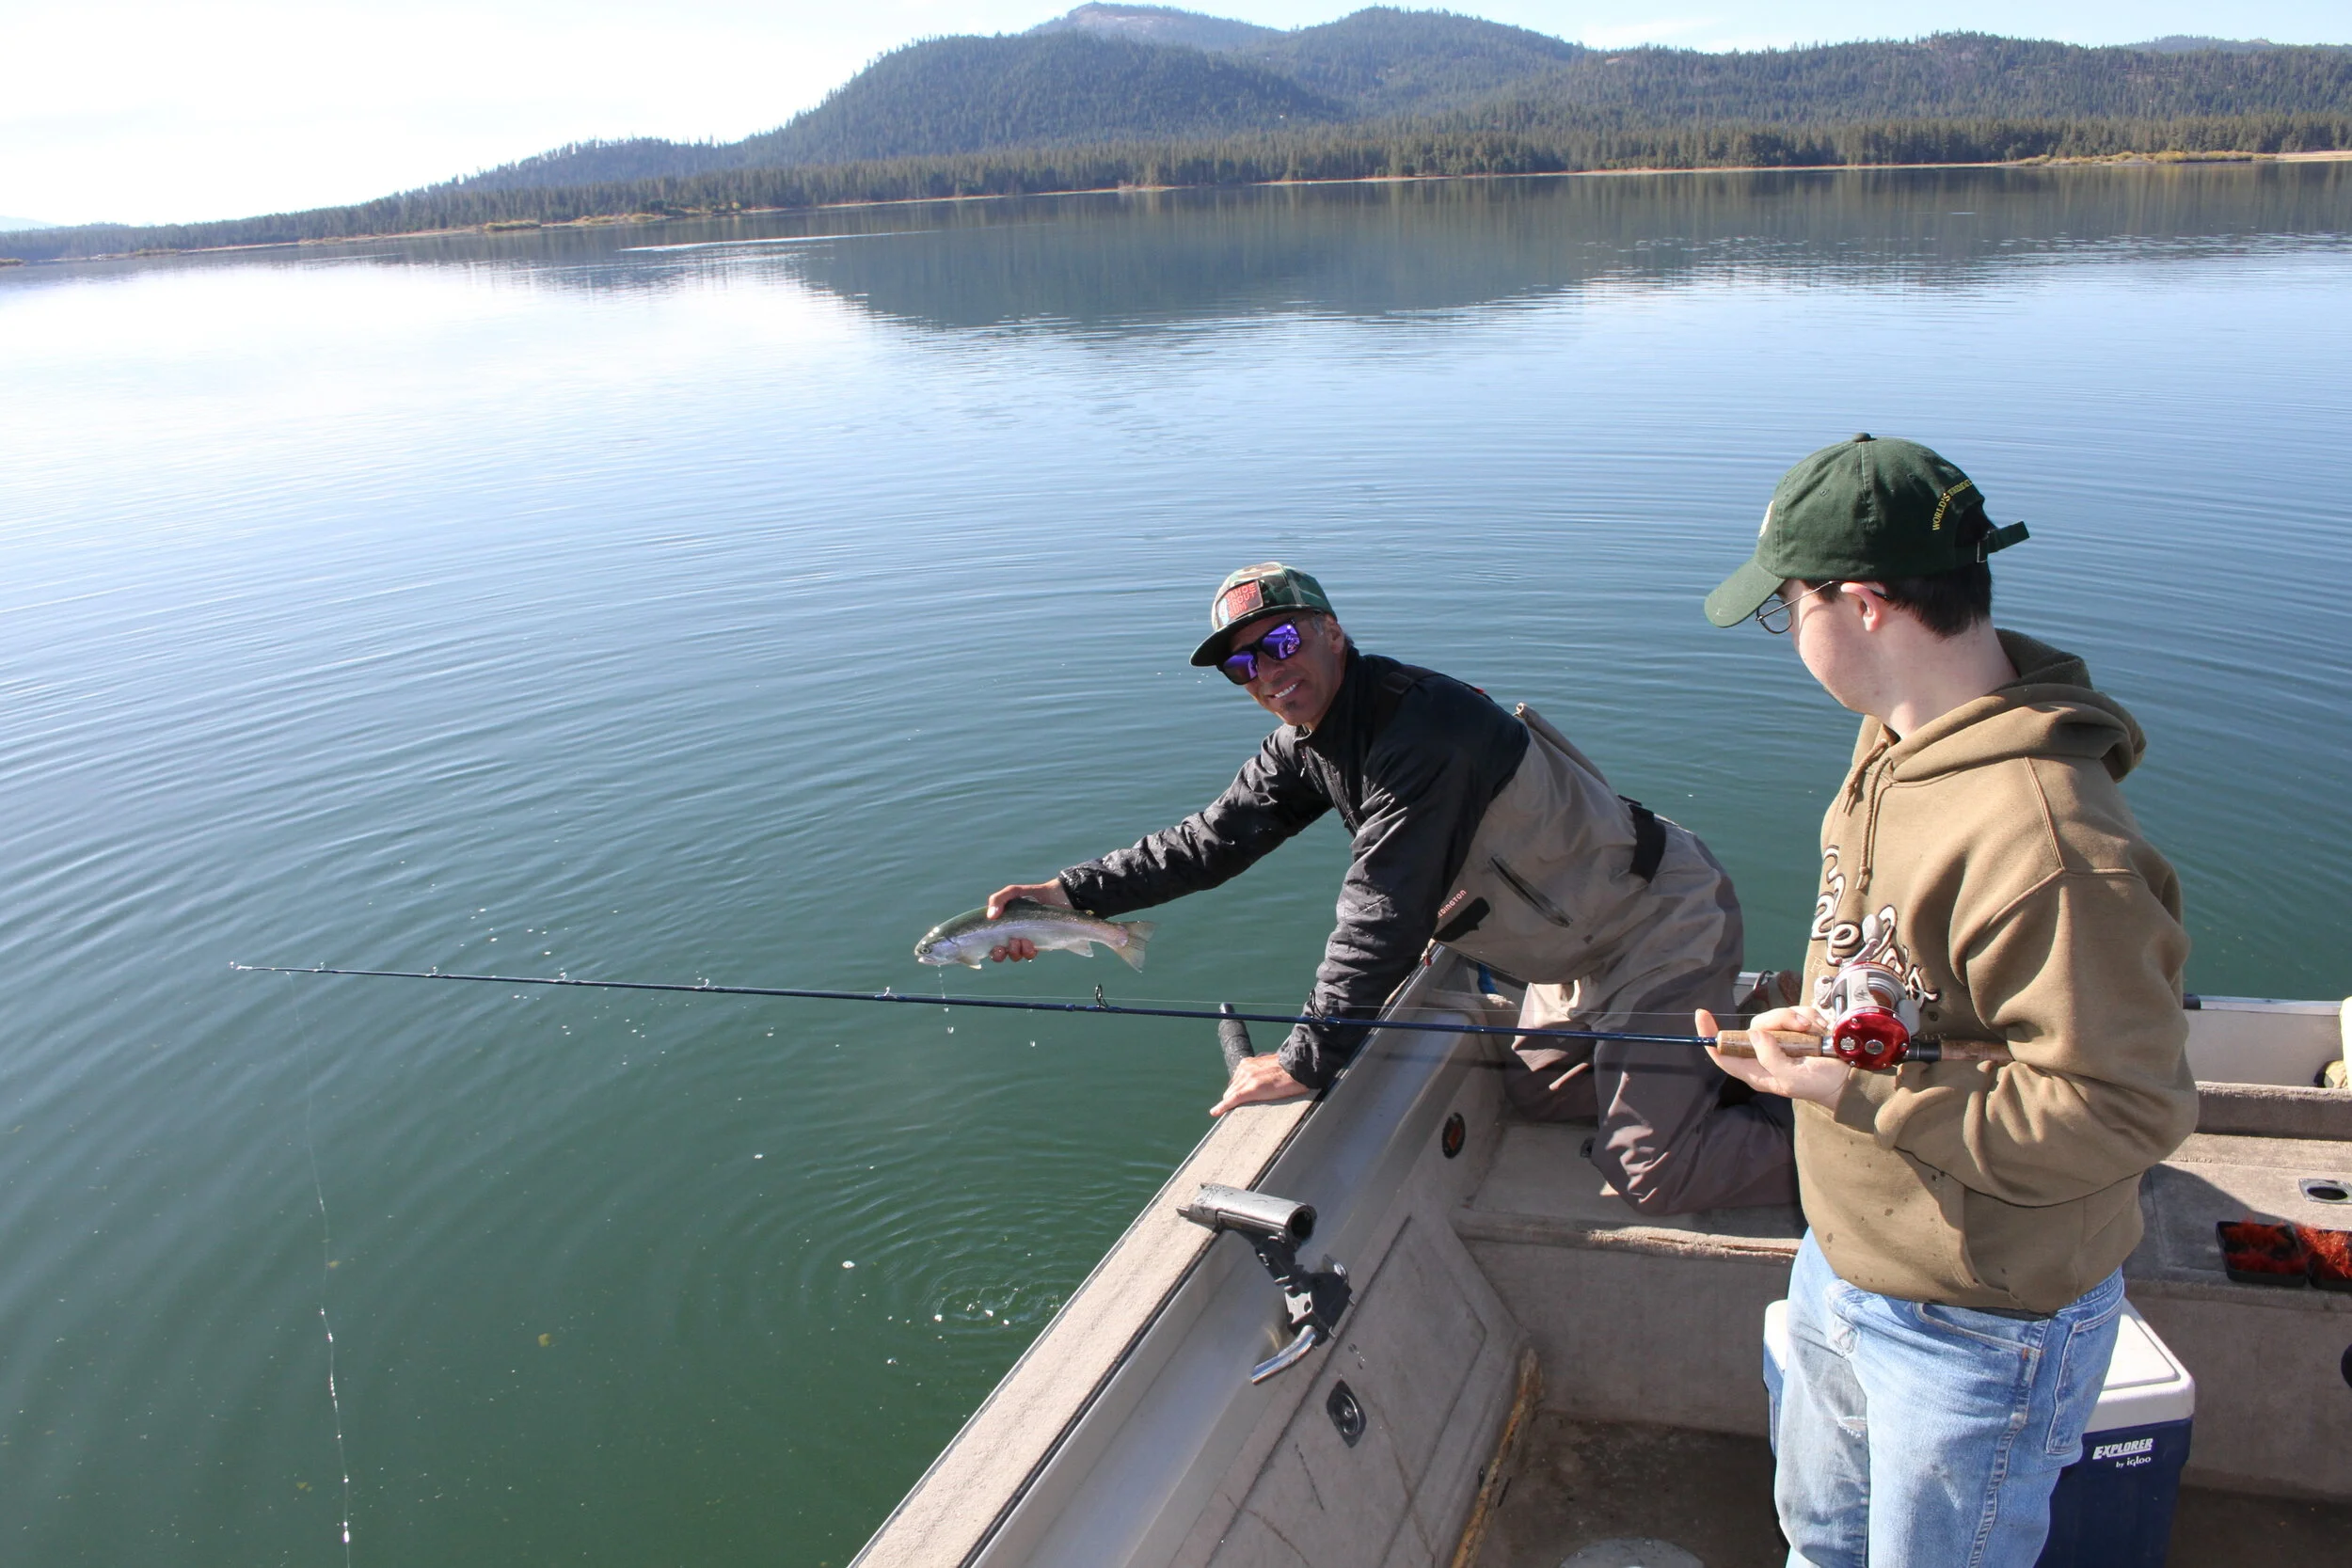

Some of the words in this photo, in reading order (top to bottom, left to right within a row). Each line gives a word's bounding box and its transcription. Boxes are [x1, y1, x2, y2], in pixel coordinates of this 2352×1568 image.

[1931, 494, 1951, 531] WORLD'S
[1225, 581, 1257, 601] TAHOE
[1228, 590, 1257, 610] TROUT
[1229, 602, 1248, 618] BUM
[2091, 1437, 2153, 1460] EXPLORER
[2126, 1455, 2152, 1466] igloo
